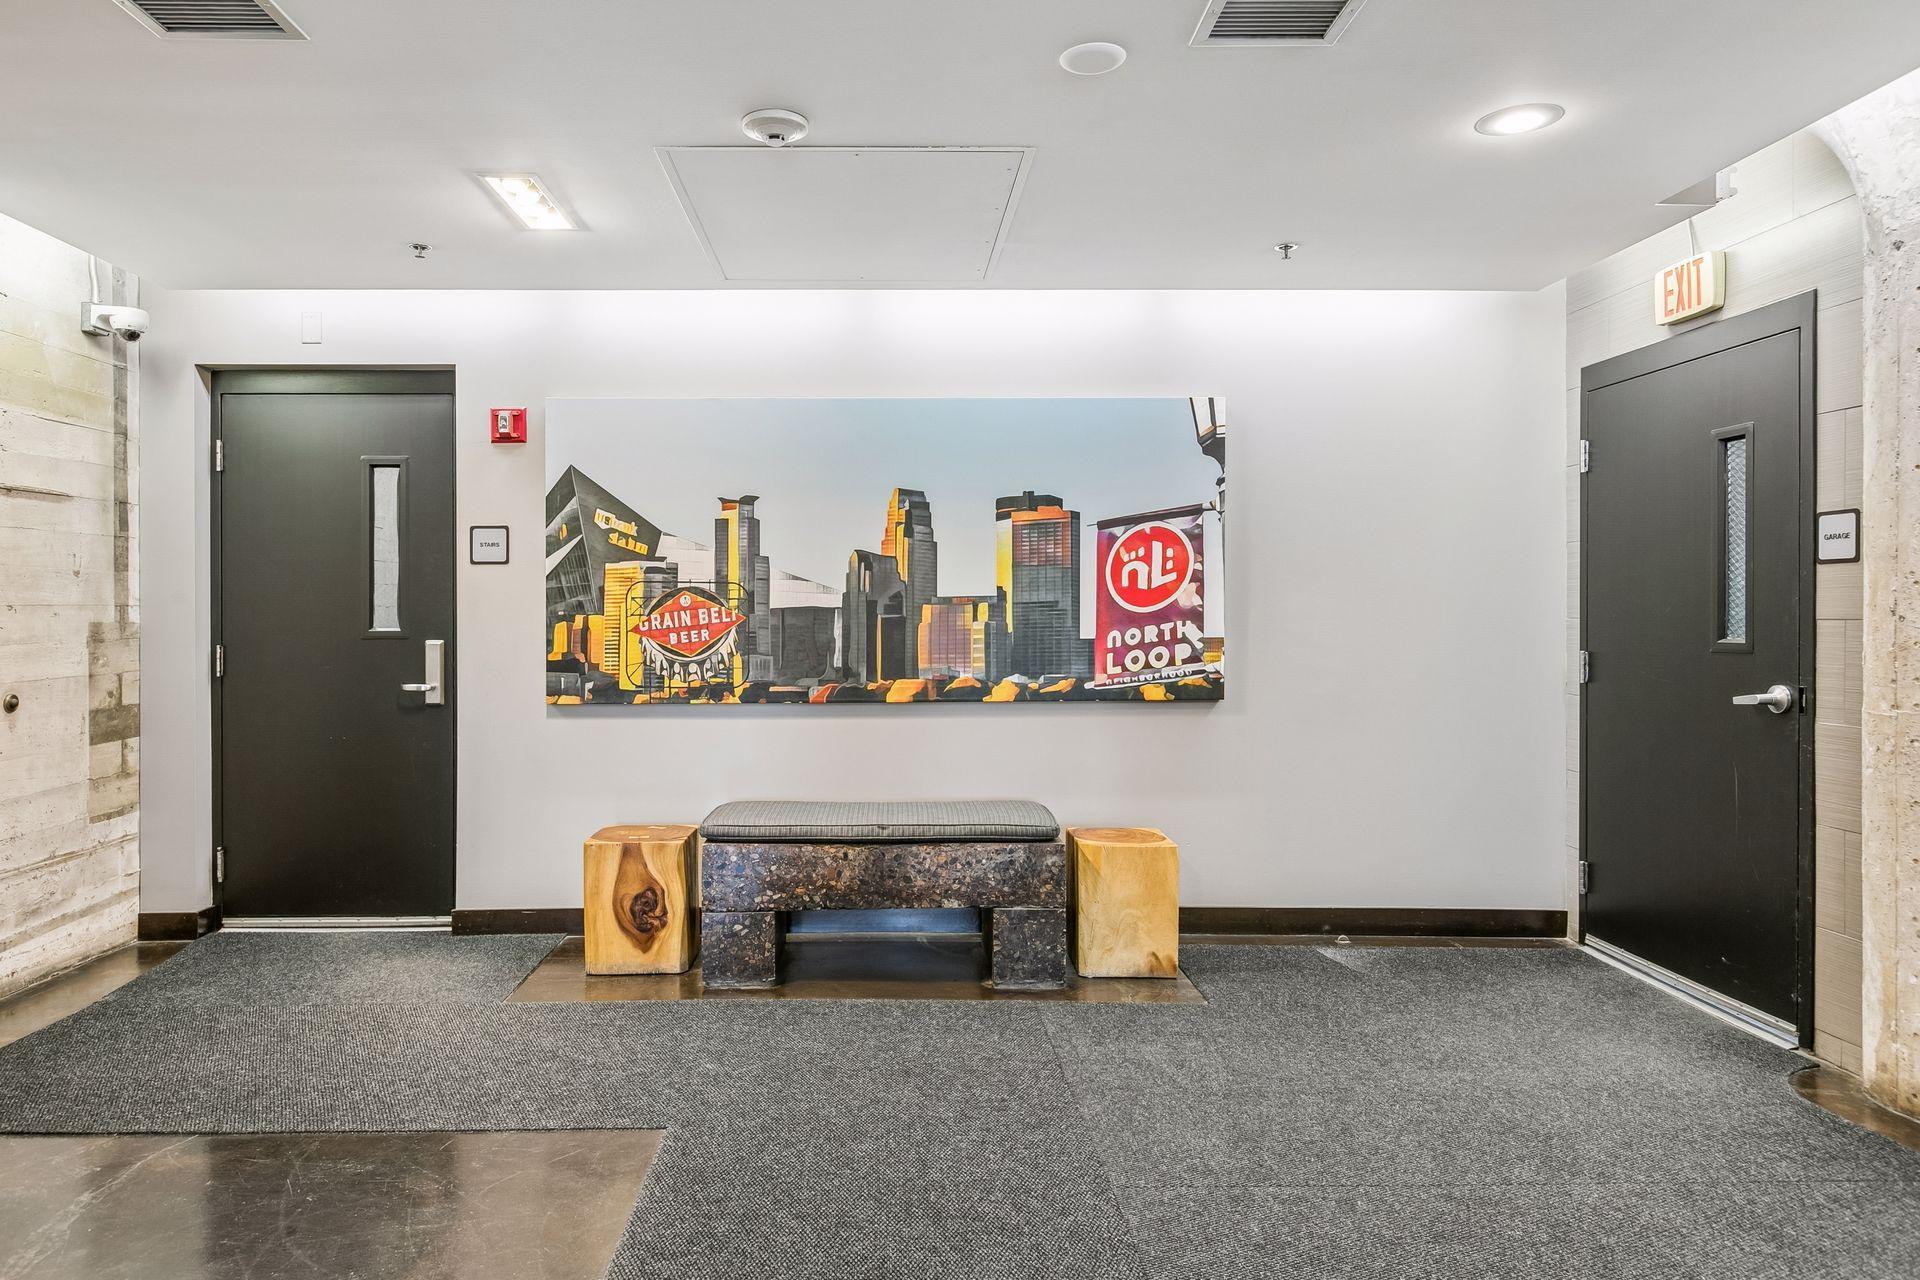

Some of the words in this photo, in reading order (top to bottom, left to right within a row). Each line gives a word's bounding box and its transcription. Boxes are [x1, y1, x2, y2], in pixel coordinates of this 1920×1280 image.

[1663, 257, 1704, 317] EXIT
[1823, 532, 1851, 541] GARAGE
[639, 610, 692, 631] GRAIN
[698, 606, 738, 625] BELT
[669, 629, 710, 645] BEER
[1106, 643, 1192, 674] LOOP
